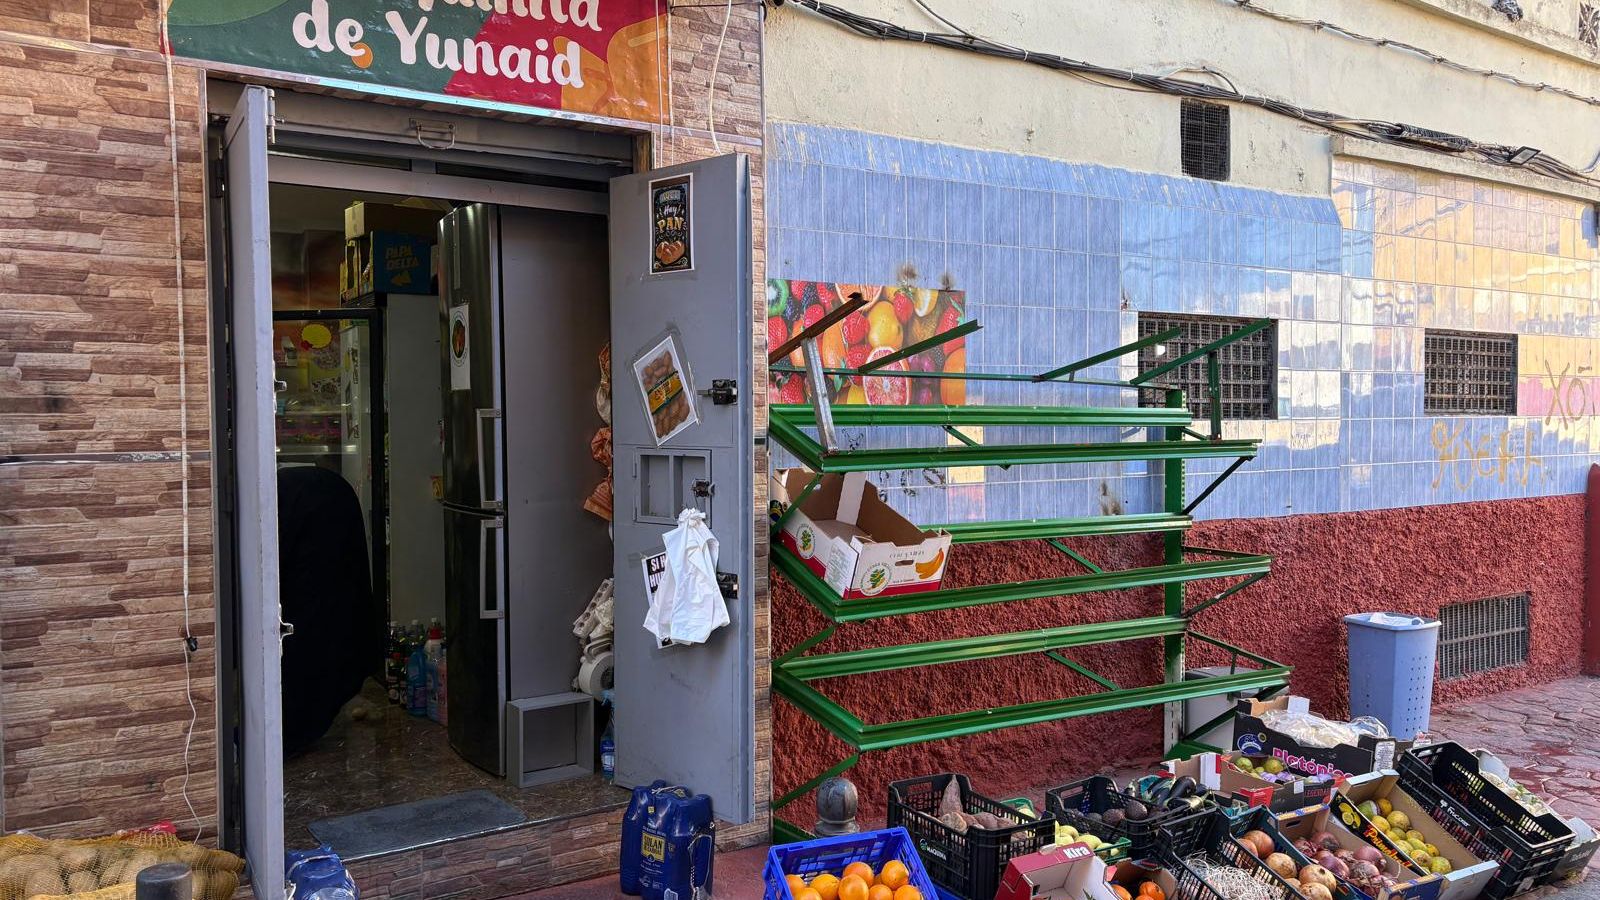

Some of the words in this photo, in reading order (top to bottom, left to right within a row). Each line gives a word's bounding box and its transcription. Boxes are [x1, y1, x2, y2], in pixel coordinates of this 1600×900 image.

[292, 0, 365, 56] de
[385, 10, 584, 89] Yunaid
[657, 216, 684, 233] PAN
[651, 557, 660, 571] SI
[1062, 846, 1091, 859] Kira
